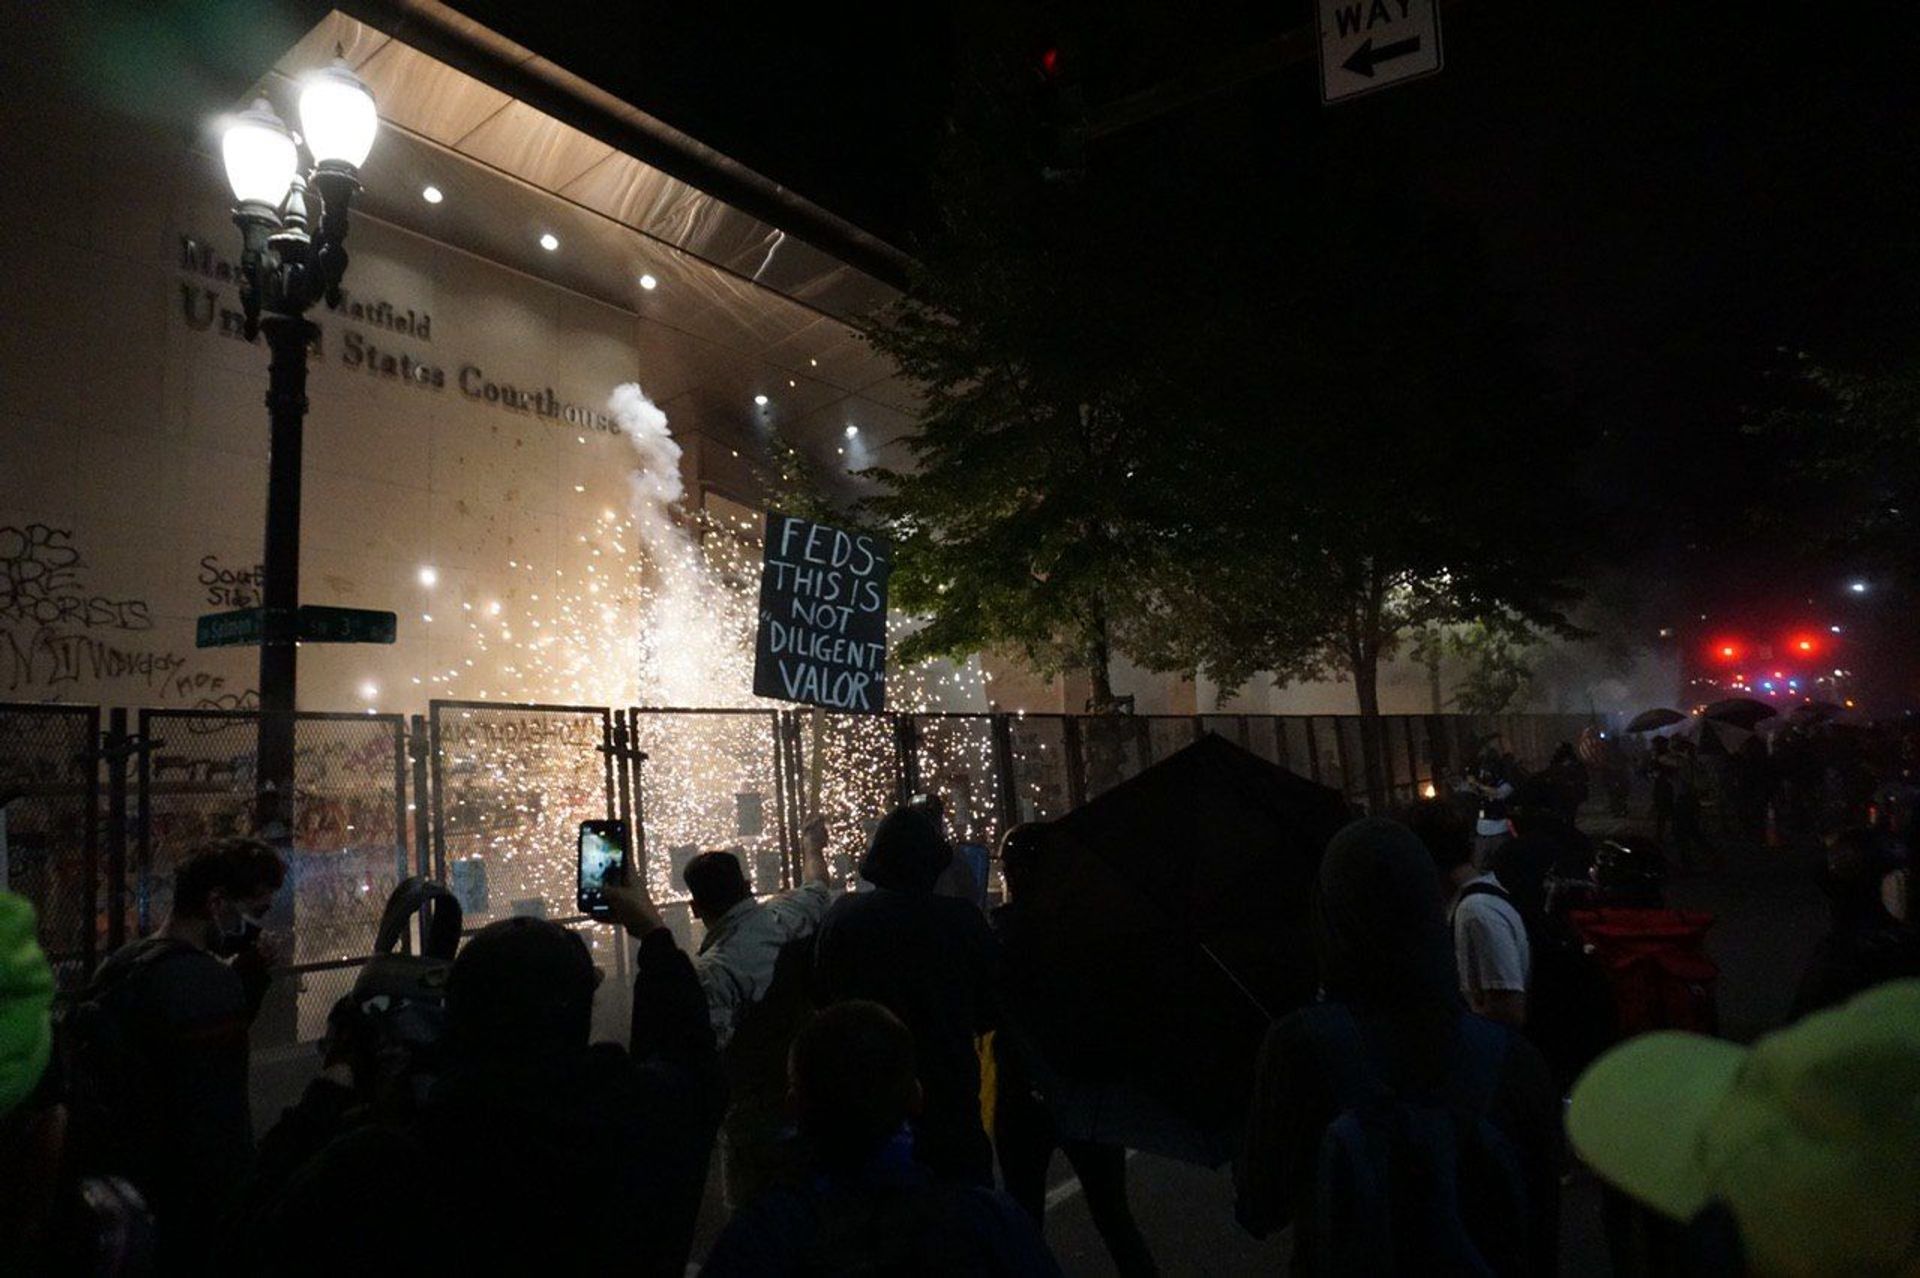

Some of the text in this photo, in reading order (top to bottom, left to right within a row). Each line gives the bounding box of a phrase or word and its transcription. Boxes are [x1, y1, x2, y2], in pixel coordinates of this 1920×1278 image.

[337, 296, 431, 342] atfield
[343, 331, 445, 390] States
[458, 365, 621, 436] Courthouse
[768, 559, 881, 613] THIS IS
[760, 610, 885, 672] "DILIGENT
[791, 597, 855, 635] NOT
[778, 659, 884, 711] VALOR"
